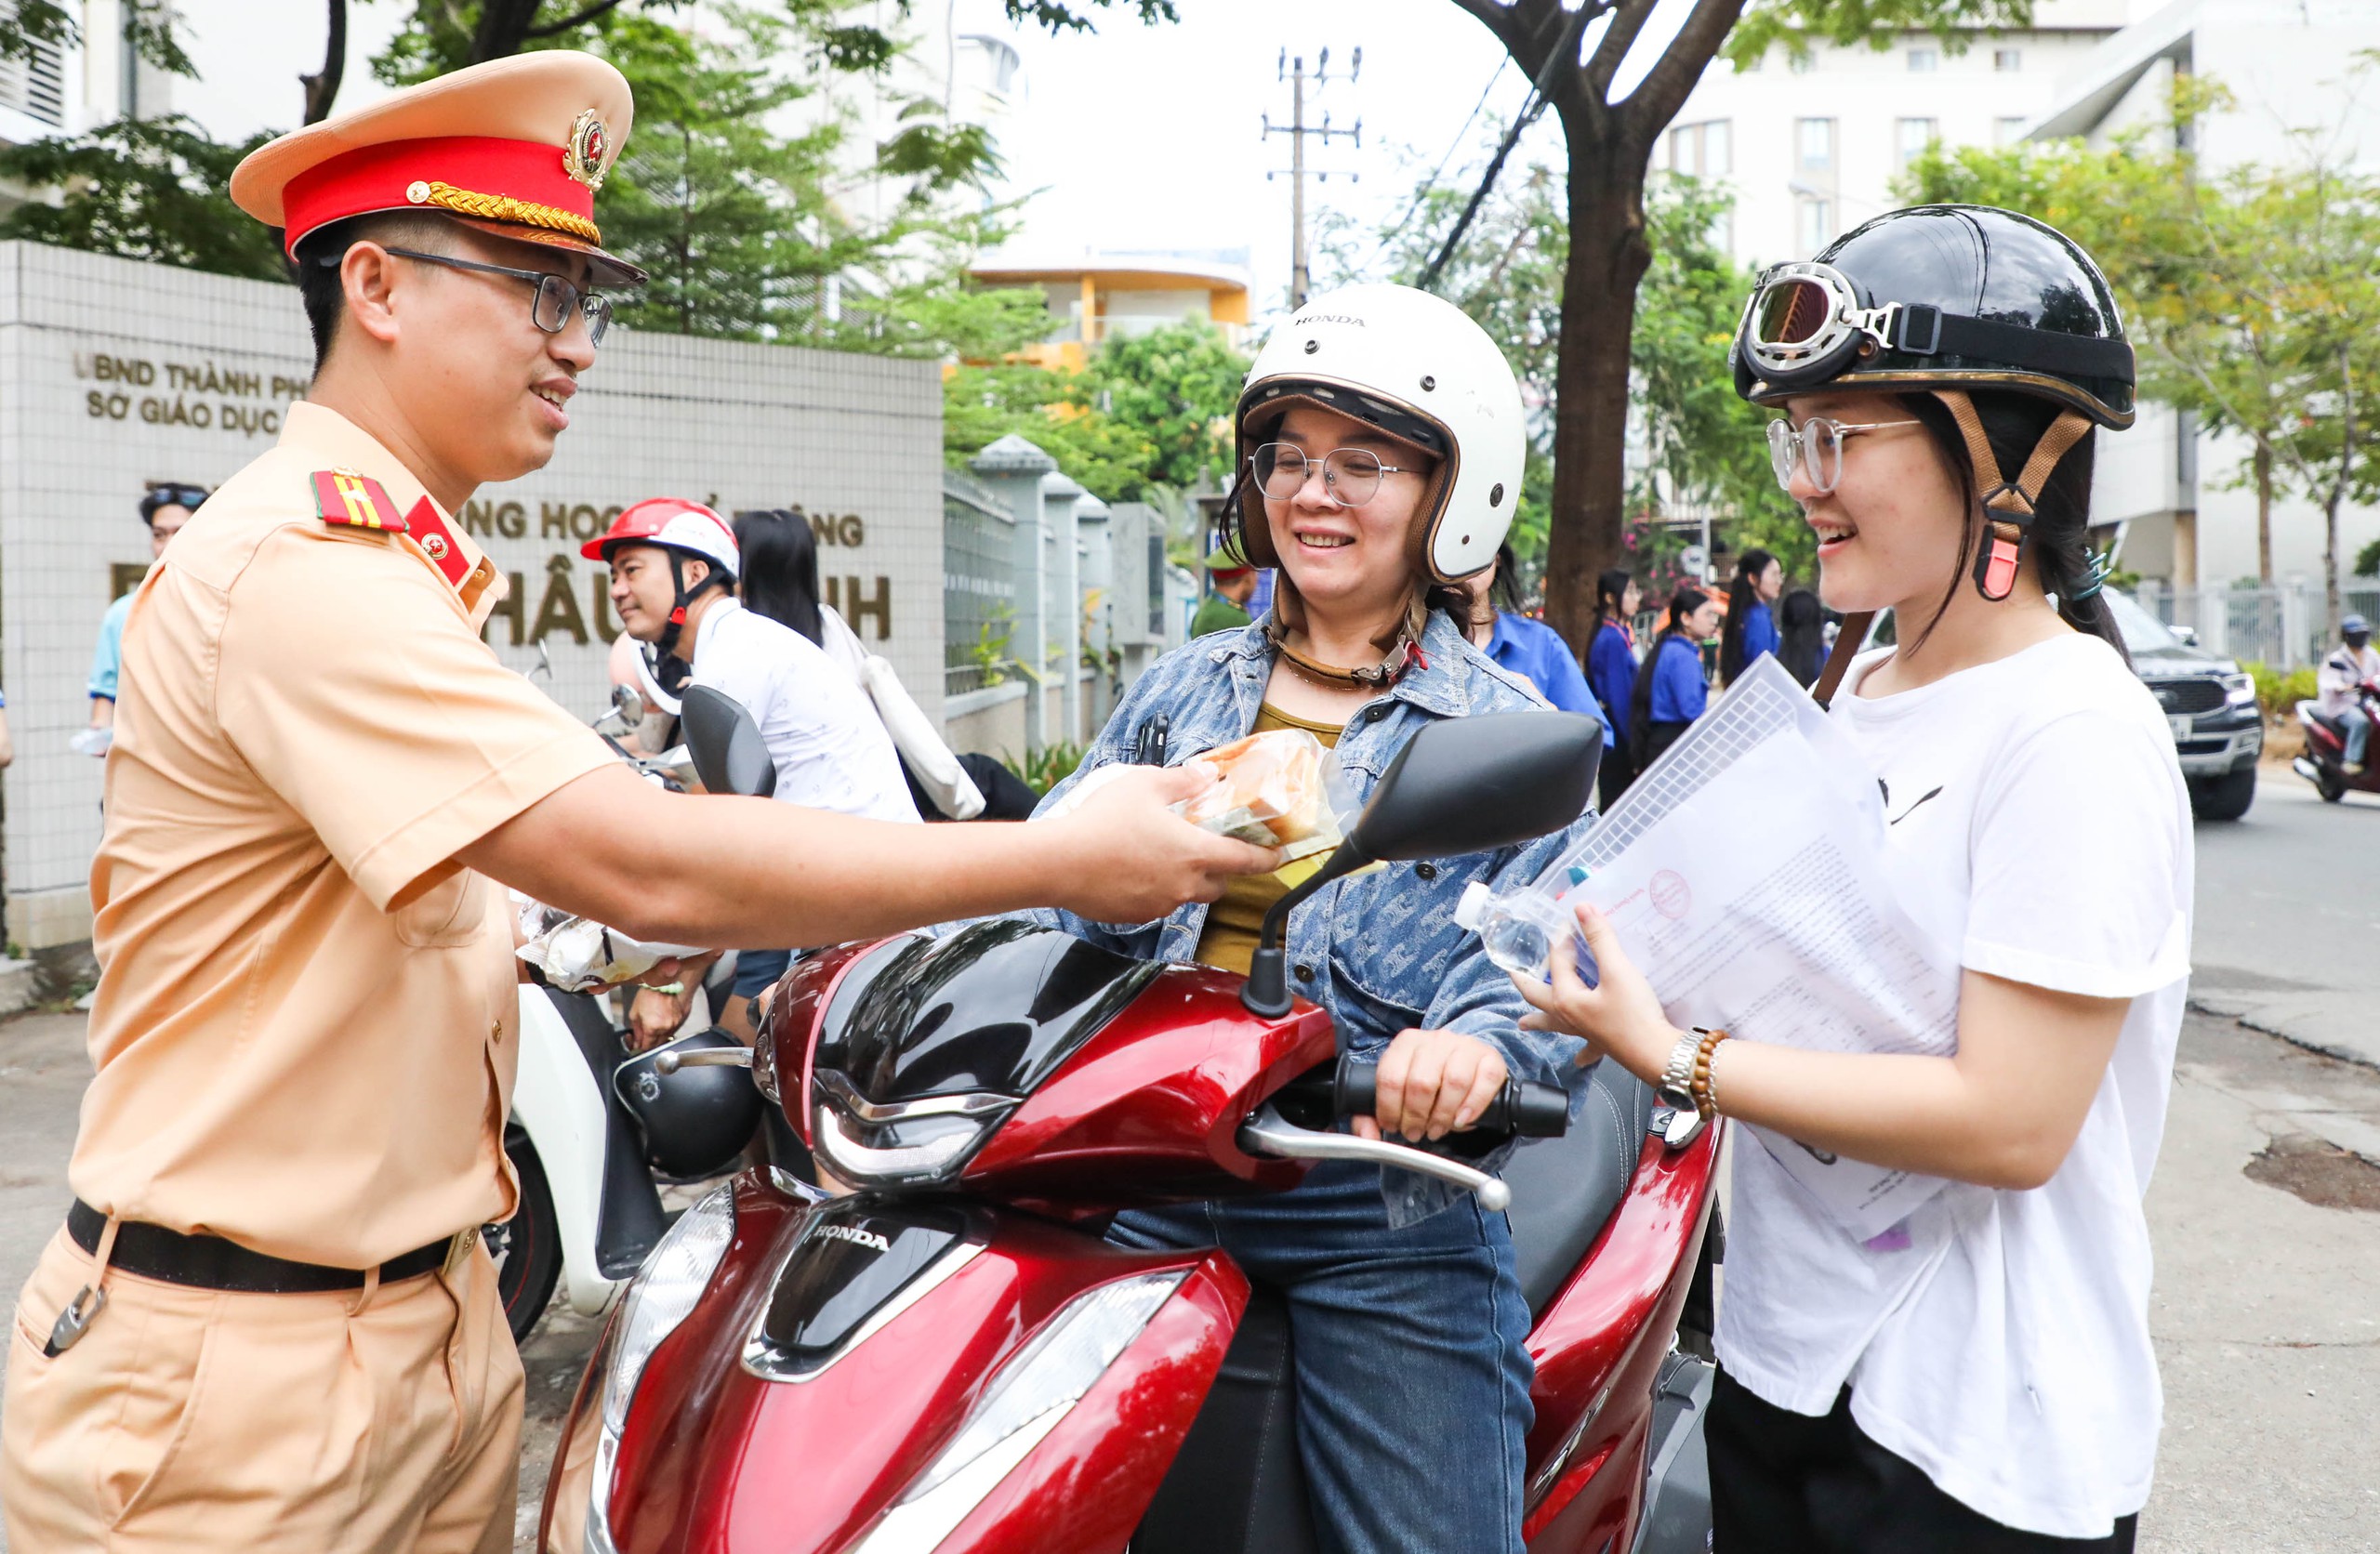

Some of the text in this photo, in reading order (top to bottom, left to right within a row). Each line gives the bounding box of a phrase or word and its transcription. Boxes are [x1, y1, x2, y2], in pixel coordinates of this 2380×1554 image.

[1295, 315, 1365, 326] HONDA
[165, 361, 260, 398] THÀNH
[271, 375, 313, 401] PH
[140, 393, 212, 428] GIÁO
[221, 403, 278, 439] DỤC
[813, 1225, 891, 1253] HONDA
